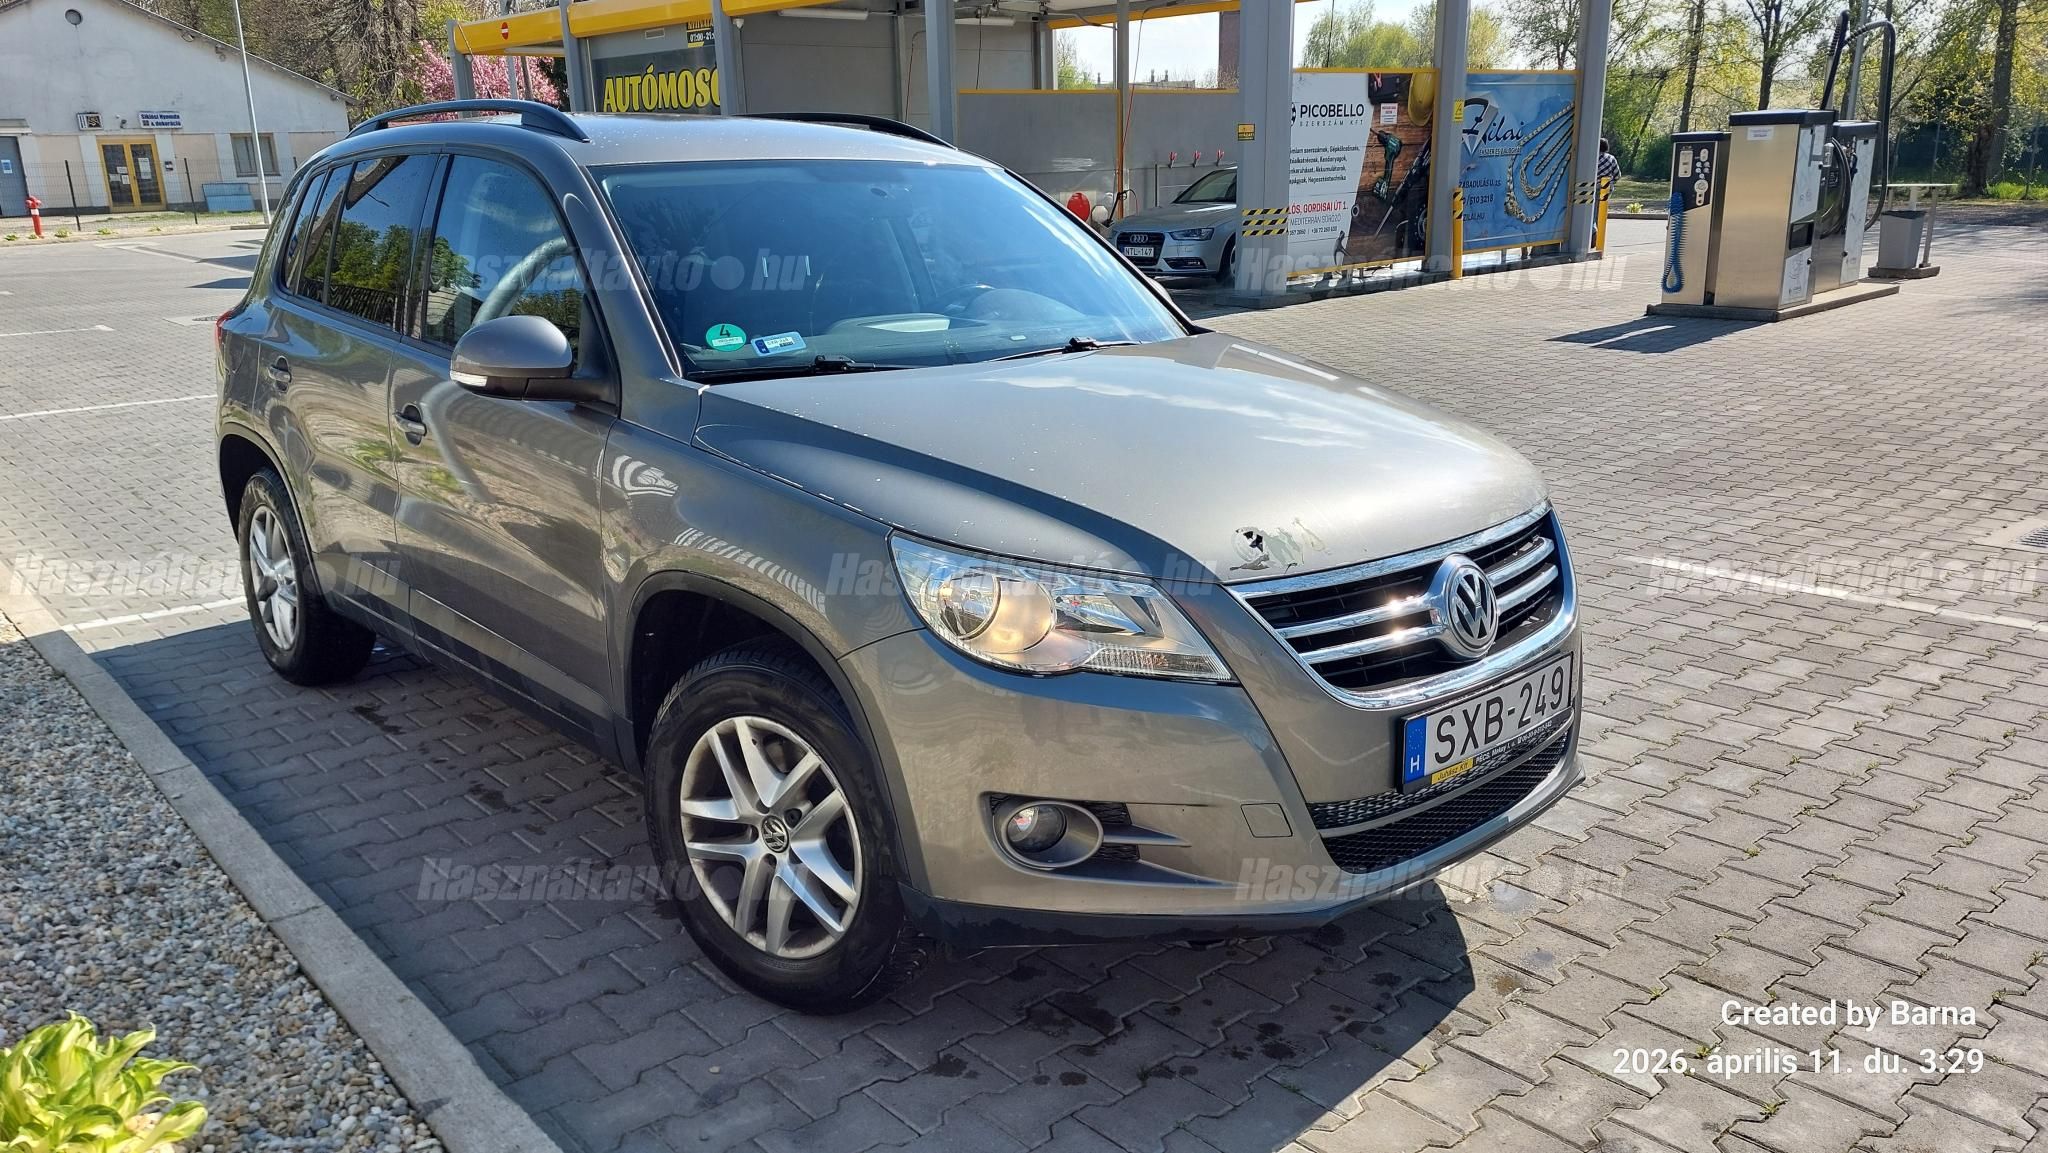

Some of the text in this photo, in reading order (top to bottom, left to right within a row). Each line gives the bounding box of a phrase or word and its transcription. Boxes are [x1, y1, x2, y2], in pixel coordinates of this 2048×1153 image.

[1300, 104, 1364, 118] PICOBELLO
[1303, 202, 1333, 213] GORDISAI
[1334, 200, 1342, 210] ÚT
[1124, 247, 1153, 256] NTL-147
[720, 324, 731, 337] 4
[1434, 665, 1564, 764] SXB-249
[1410, 755, 1420, 773] H
